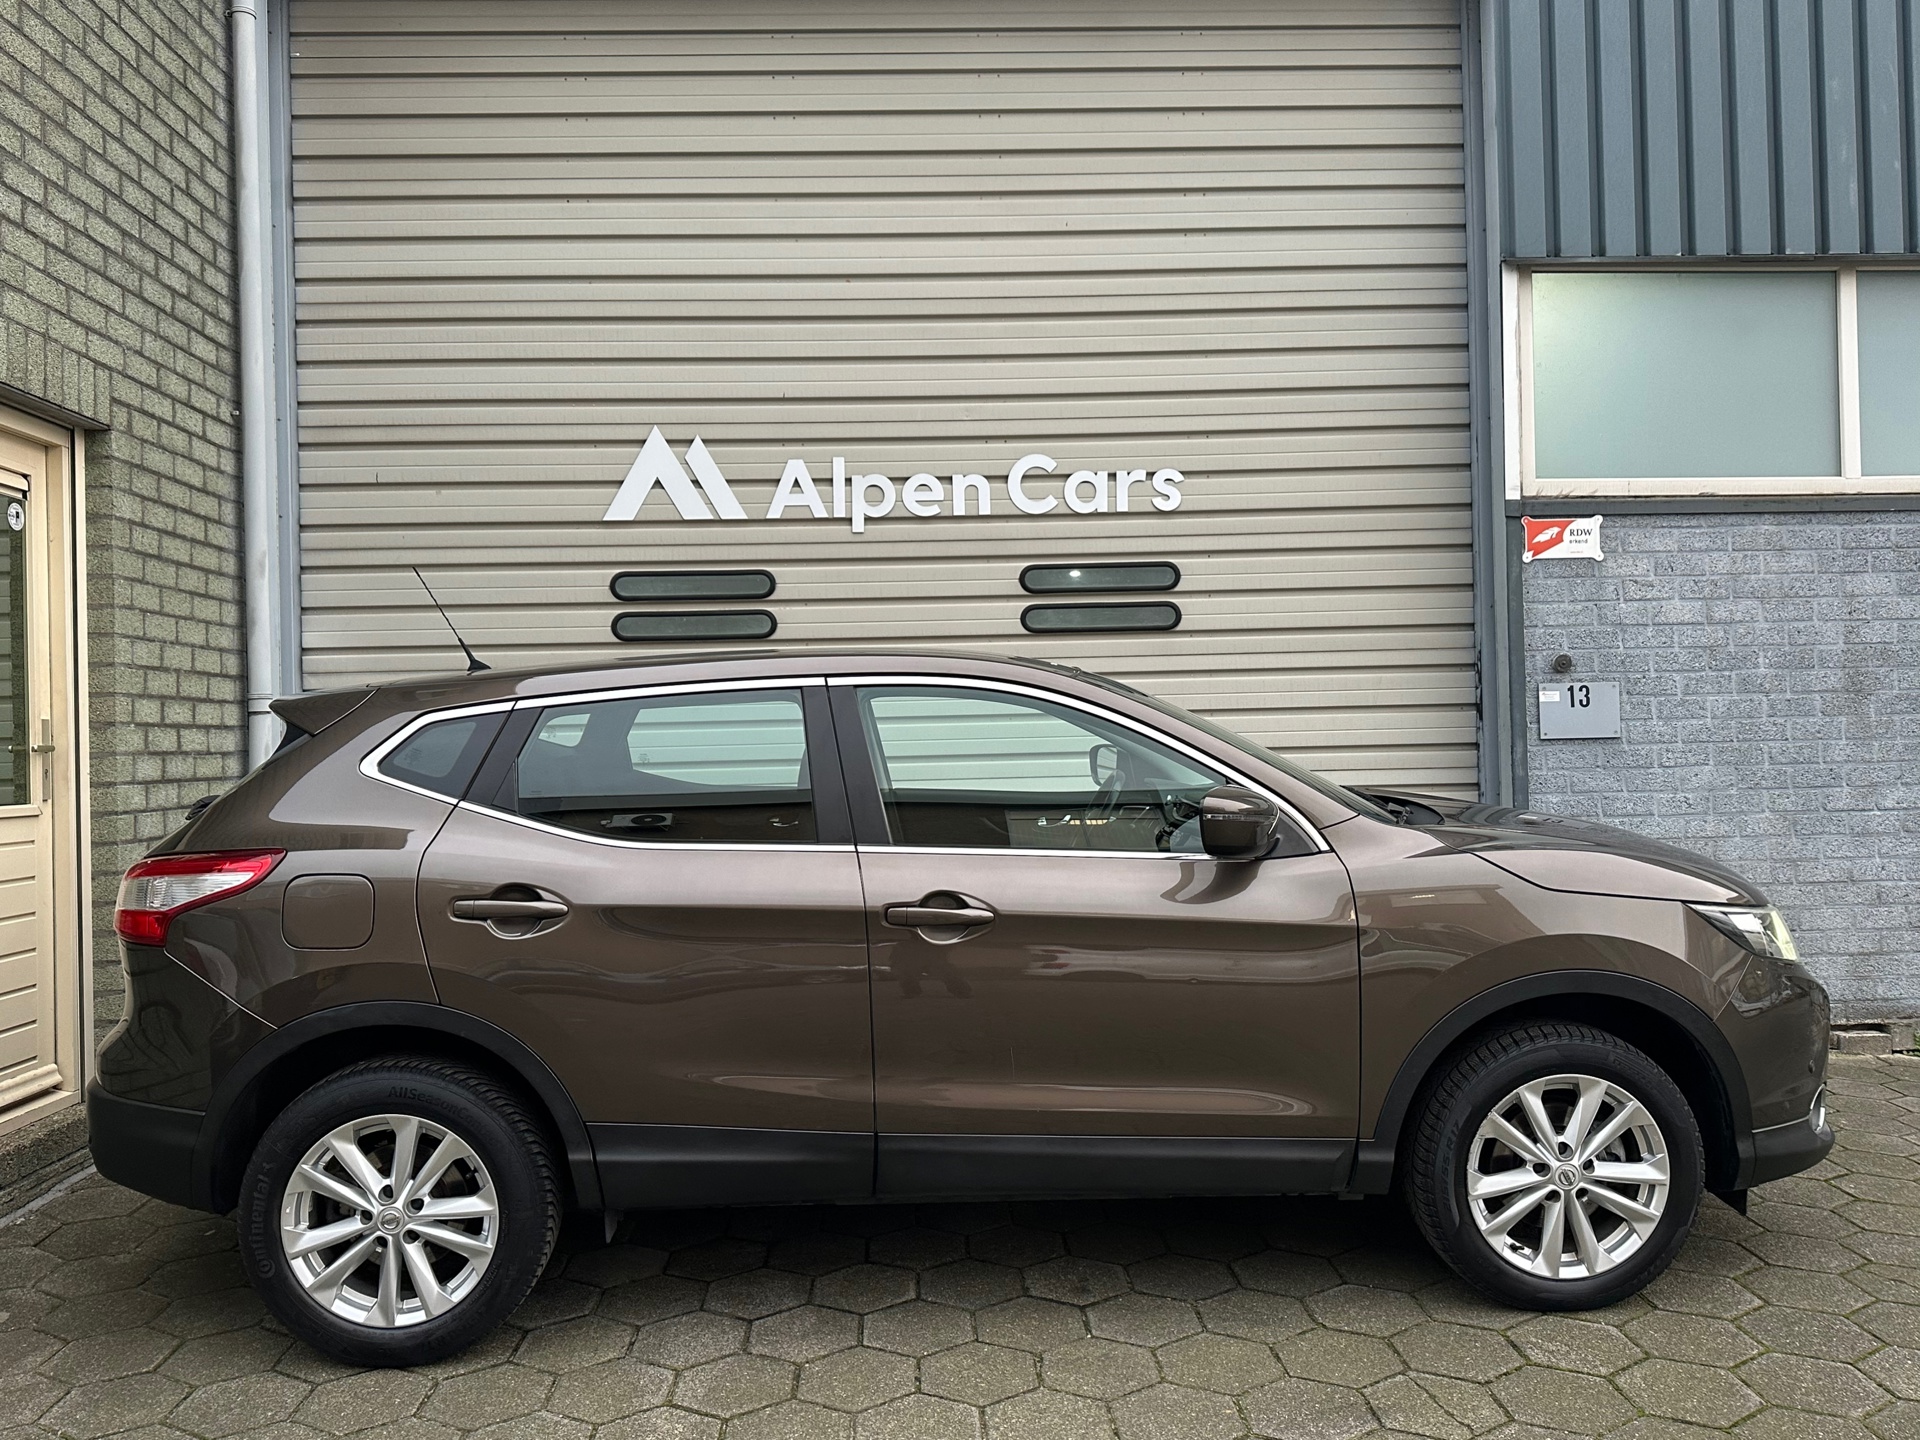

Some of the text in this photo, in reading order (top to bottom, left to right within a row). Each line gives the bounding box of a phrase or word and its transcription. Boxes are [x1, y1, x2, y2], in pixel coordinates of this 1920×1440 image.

[766, 453, 1186, 533] Alpen Cars
[1569, 528, 1593, 536] RDW
[1567, 685, 1590, 708] 13
